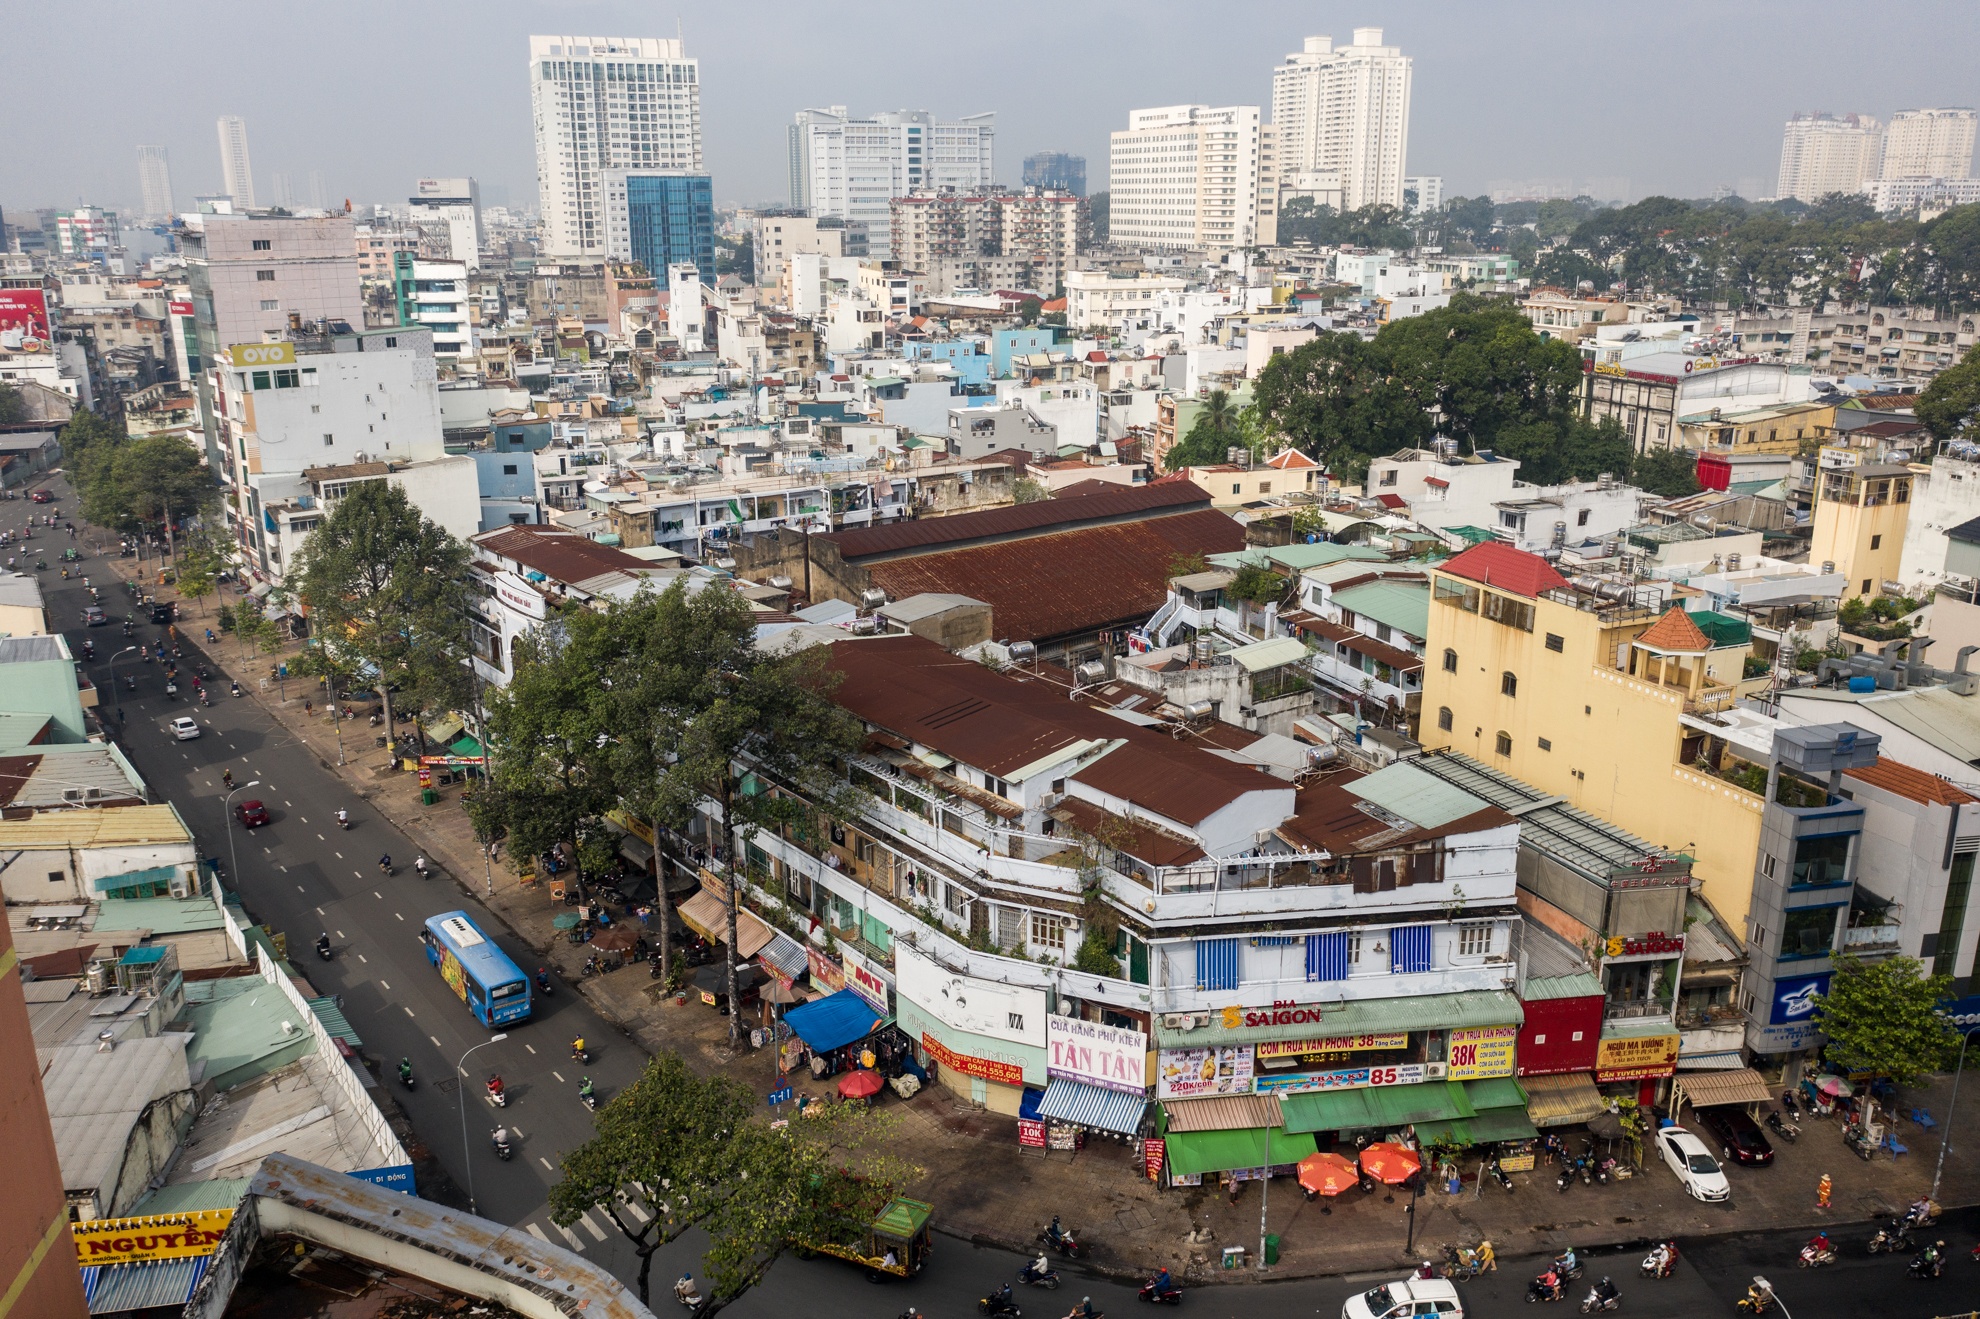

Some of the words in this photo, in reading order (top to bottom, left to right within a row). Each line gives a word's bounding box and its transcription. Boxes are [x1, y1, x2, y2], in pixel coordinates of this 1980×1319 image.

[243, 347, 284, 362] OYO
[1647, 931, 1665, 940] BIA
[1625, 937, 1685, 955] SAIGON
[855, 965, 883, 995] MT
[1273, 1000, 1297, 1010] BIA
[907, 1011, 942, 1042] MUMUSO
[1245, 1009, 1322, 1027] SAIGON
[1098, 1030, 1116, 1044] PHỤ
[1119, 1034, 1141, 1048] KIỆN
[1358, 1034, 1374, 1047] 38
[1627, 1041, 1639, 1050] MA
[971, 1046, 1028, 1068] MUMUSO
[1050, 1038, 1092, 1072] TÂN
[1099, 1048, 1141, 1083] TÂN
[1451, 1044, 1477, 1067] 38K
[967, 1063, 1020, 1080] 0944.555.605
[1371, 1068, 1397, 1085] 85
[1170, 1080, 1212, 1093] 220K/con
[1023, 1128, 1041, 1137] 10K
[387, 1173, 407, 1182] ĐỘNG
[104, 1222, 141, 1233] ĐIỆN
[144, 1218, 193, 1228] THOẠI
[87, 1223, 225, 1255] NGUYỄN
